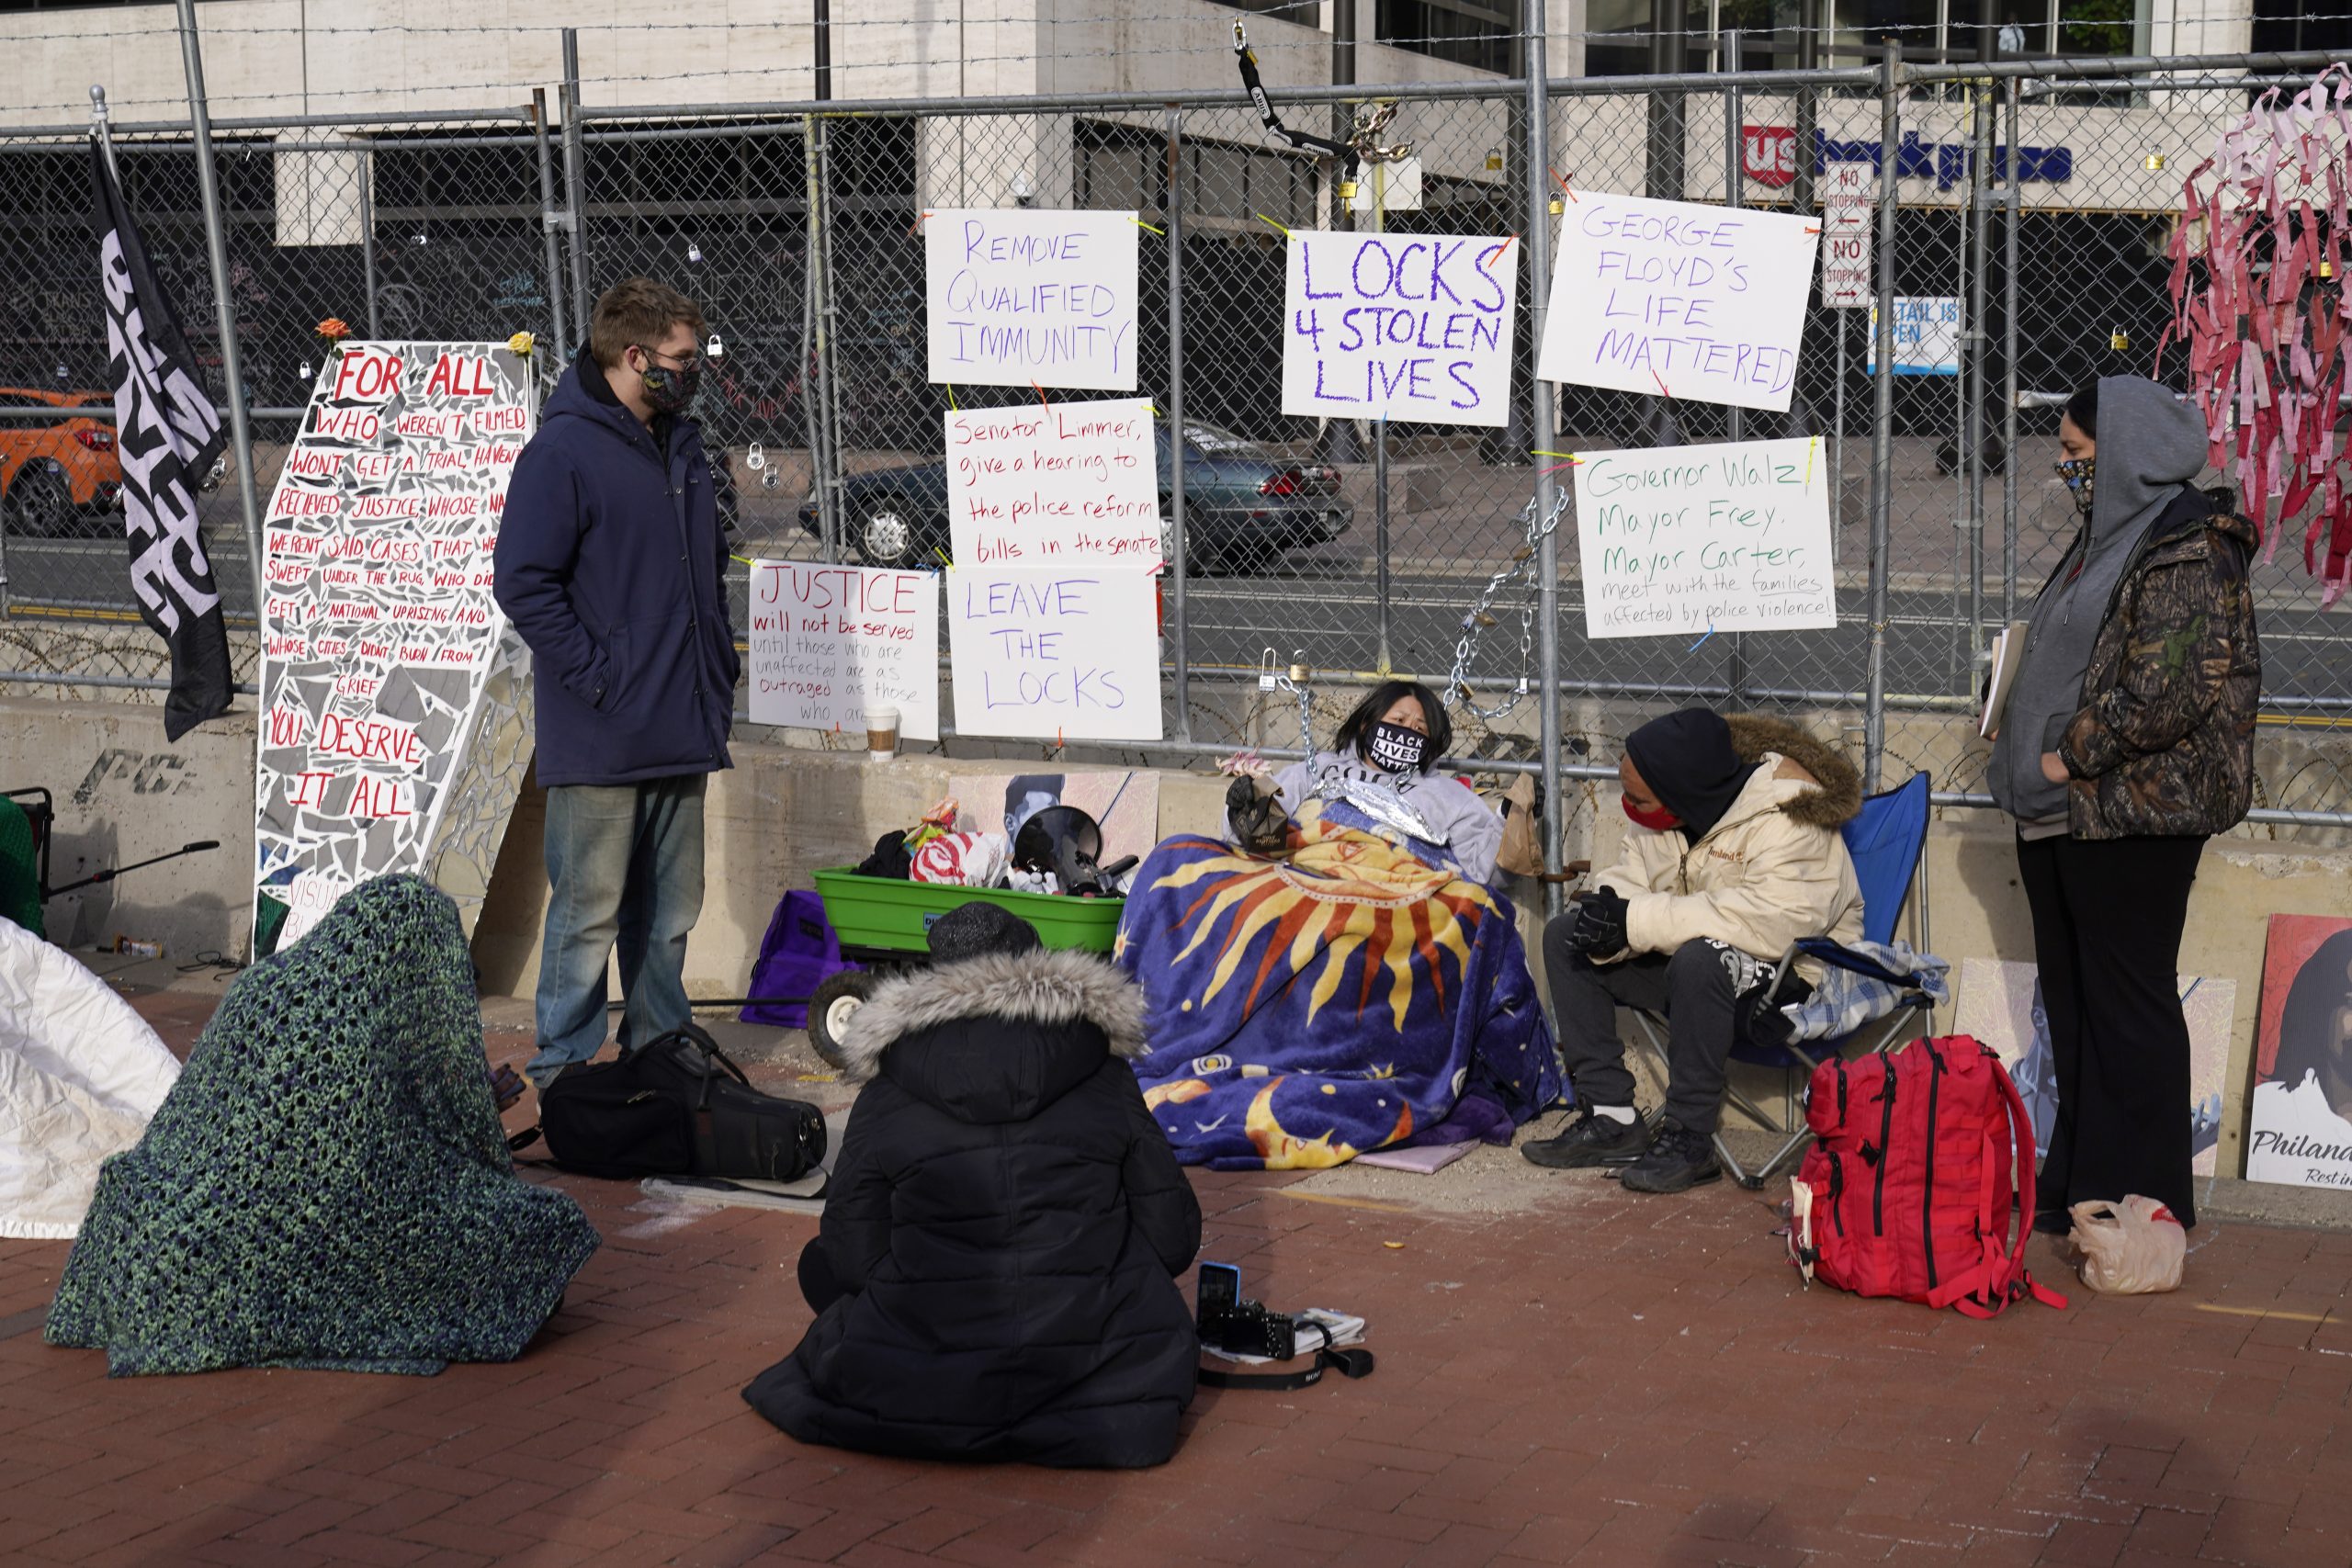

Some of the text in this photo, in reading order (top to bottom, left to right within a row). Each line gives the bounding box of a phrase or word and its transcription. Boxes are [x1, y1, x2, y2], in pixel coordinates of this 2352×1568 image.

[1840, 170, 1858, 186] NO
[1828, 195, 1869, 208] STOPPING
[1582, 206, 1744, 248] GEORGE
[965, 220, 1090, 266] REMOVE
[1834, 240, 1860, 258] NO
[1303, 239, 1506, 313] LOCKS
[1598, 251, 1749, 292] FLOYD'S
[1827, 269, 1866, 283] STOPPING
[947, 269, 1114, 317] QUALIFIED
[1606, 288, 1714, 328] LIFE
[1940, 303, 1957, 321] IS
[1295, 307, 1501, 353] 4 STOLEN
[1873, 323, 1921, 343] EN
[947, 320, 1131, 373] IMMUNITY
[1595, 328, 1794, 395] MATTERED
[335, 351, 494, 400] FOR ALL
[1314, 357, 1480, 410] LIVES
[317, 408, 379, 439] WHO
[955, 412, 1141, 445] Senator Limmer,
[357, 456, 393, 479] GET
[402, 457, 413, 470] A
[960, 447, 1137, 486] give a hearing to
[1588, 458, 1709, 497] Governor
[275, 488, 340, 516] RECIEVED
[428, 496, 479, 517] WHOSE
[968, 491, 1152, 524] the police reform
[1599, 503, 1690, 544] Mayor
[371, 538, 419, 561] CASES
[433, 540, 472, 558] THAT
[482, 535, 496, 552] WE
[977, 530, 1023, 563] bills
[1041, 538, 1061, 555] in
[1075, 532, 1103, 551] the
[1604, 541, 1805, 582] Mayor Carter,
[265, 560, 311, 582] SWEPT
[323, 569, 357, 584] UNDER
[367, 570, 387, 584] THE
[435, 570, 465, 586] WHO
[1601, 570, 1823, 601] meet with the families
[760, 564, 922, 615] JUSTICE
[966, 580, 1100, 619] LEAVE
[268, 599, 485, 624] GET A NATIONAL UPRISING AND
[754, 610, 914, 640] will not be served
[1604, 604, 1673, 626] affected
[1683, 603, 1700, 628] by
[1706, 603, 1748, 625] police
[268, 637, 305, 656] WHOSE
[318, 639, 346, 654] CITIES
[400, 646, 428, 662] BURN
[441, 649, 472, 664] FROM
[753, 634, 902, 660] until those who are
[989, 628, 1064, 660] THE
[756, 655, 900, 681] unaffected are as
[336, 674, 379, 695] GRIEF
[846, 683, 865, 695] as
[875, 681, 922, 703] those
[983, 666, 1125, 710] LOCKS
[800, 701, 831, 721] who
[271, 707, 420, 763] YOU DESERVE
[1374, 740, 1418, 760] LIVES
[1377, 727, 1423, 748] BLACK
[1371, 750, 1419, 771] MATT
[289, 772, 412, 818] IT ALL
[2305, 1168, 2338, 1183] Rest
